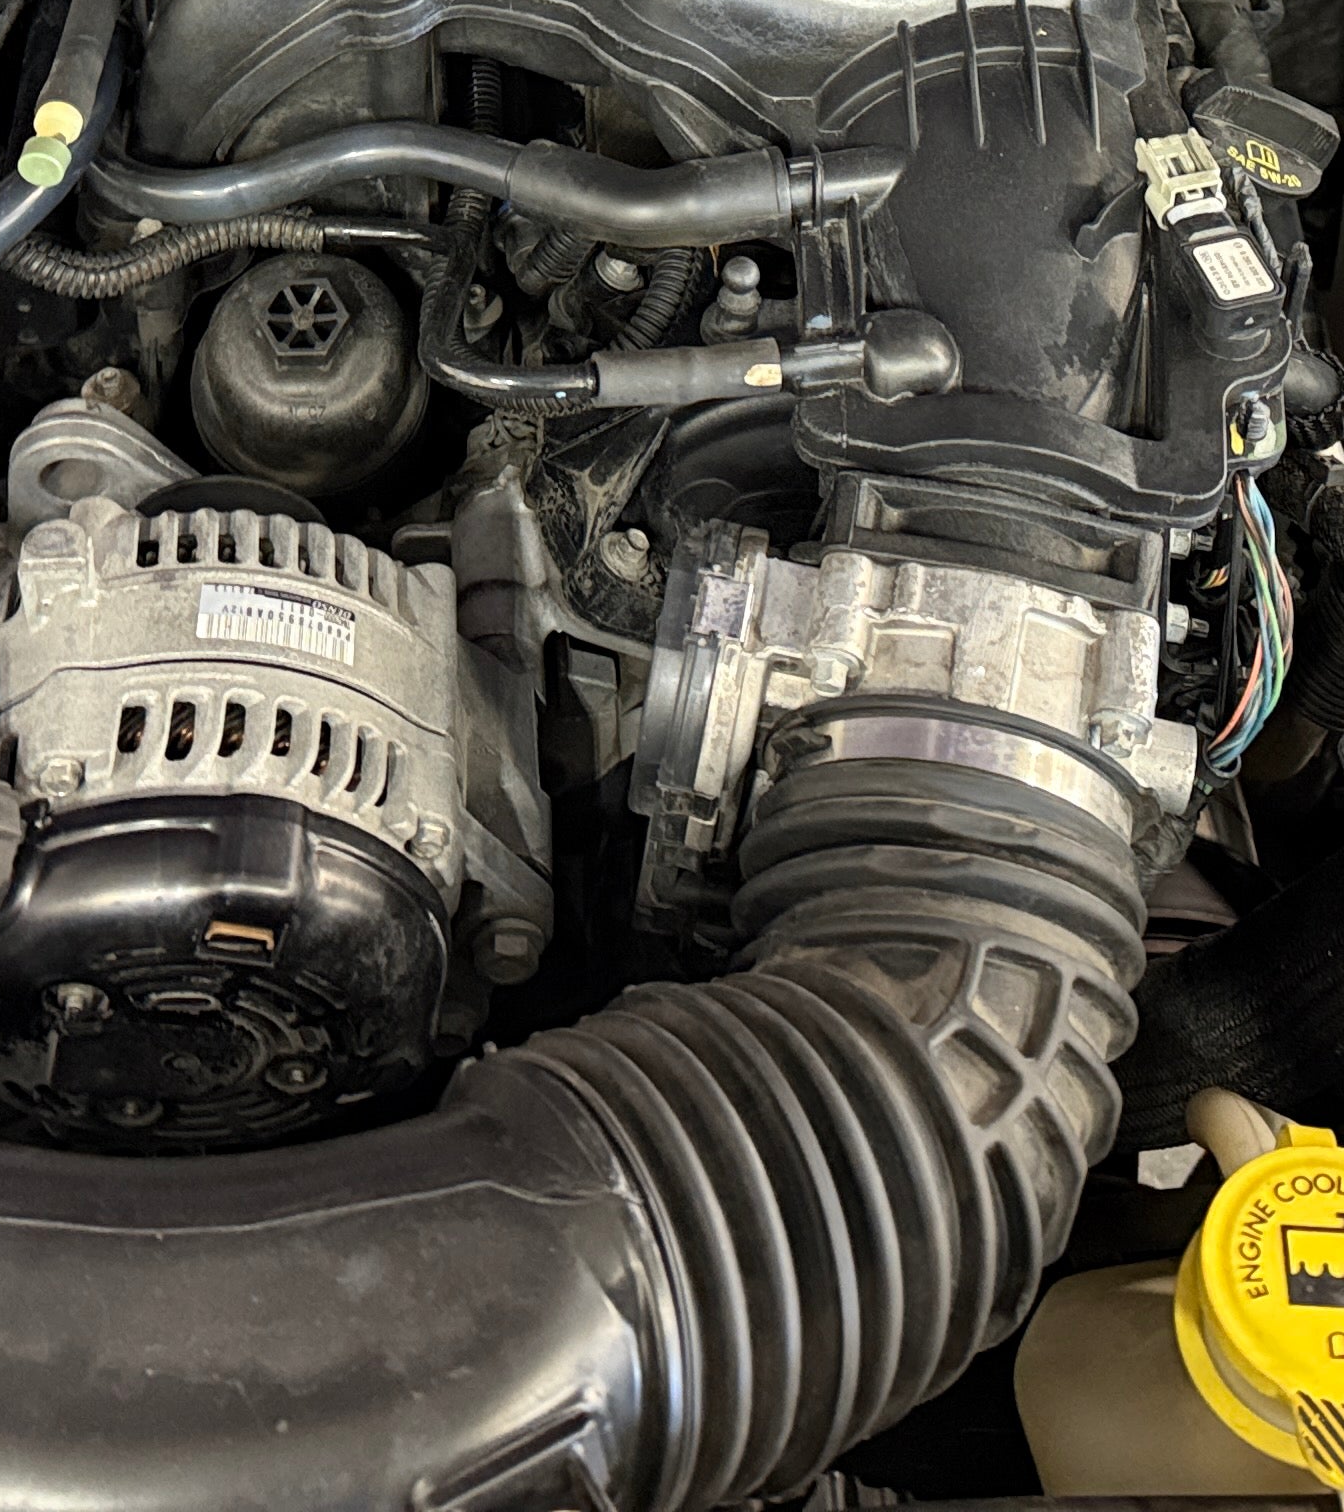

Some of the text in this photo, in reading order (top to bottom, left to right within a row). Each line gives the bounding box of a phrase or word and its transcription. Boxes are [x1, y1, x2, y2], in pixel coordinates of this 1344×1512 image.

[1226, 145, 1256, 173] SAE
[312, 600, 351, 618] DENSO
[1238, 1197, 1276, 1300] ENGINE
